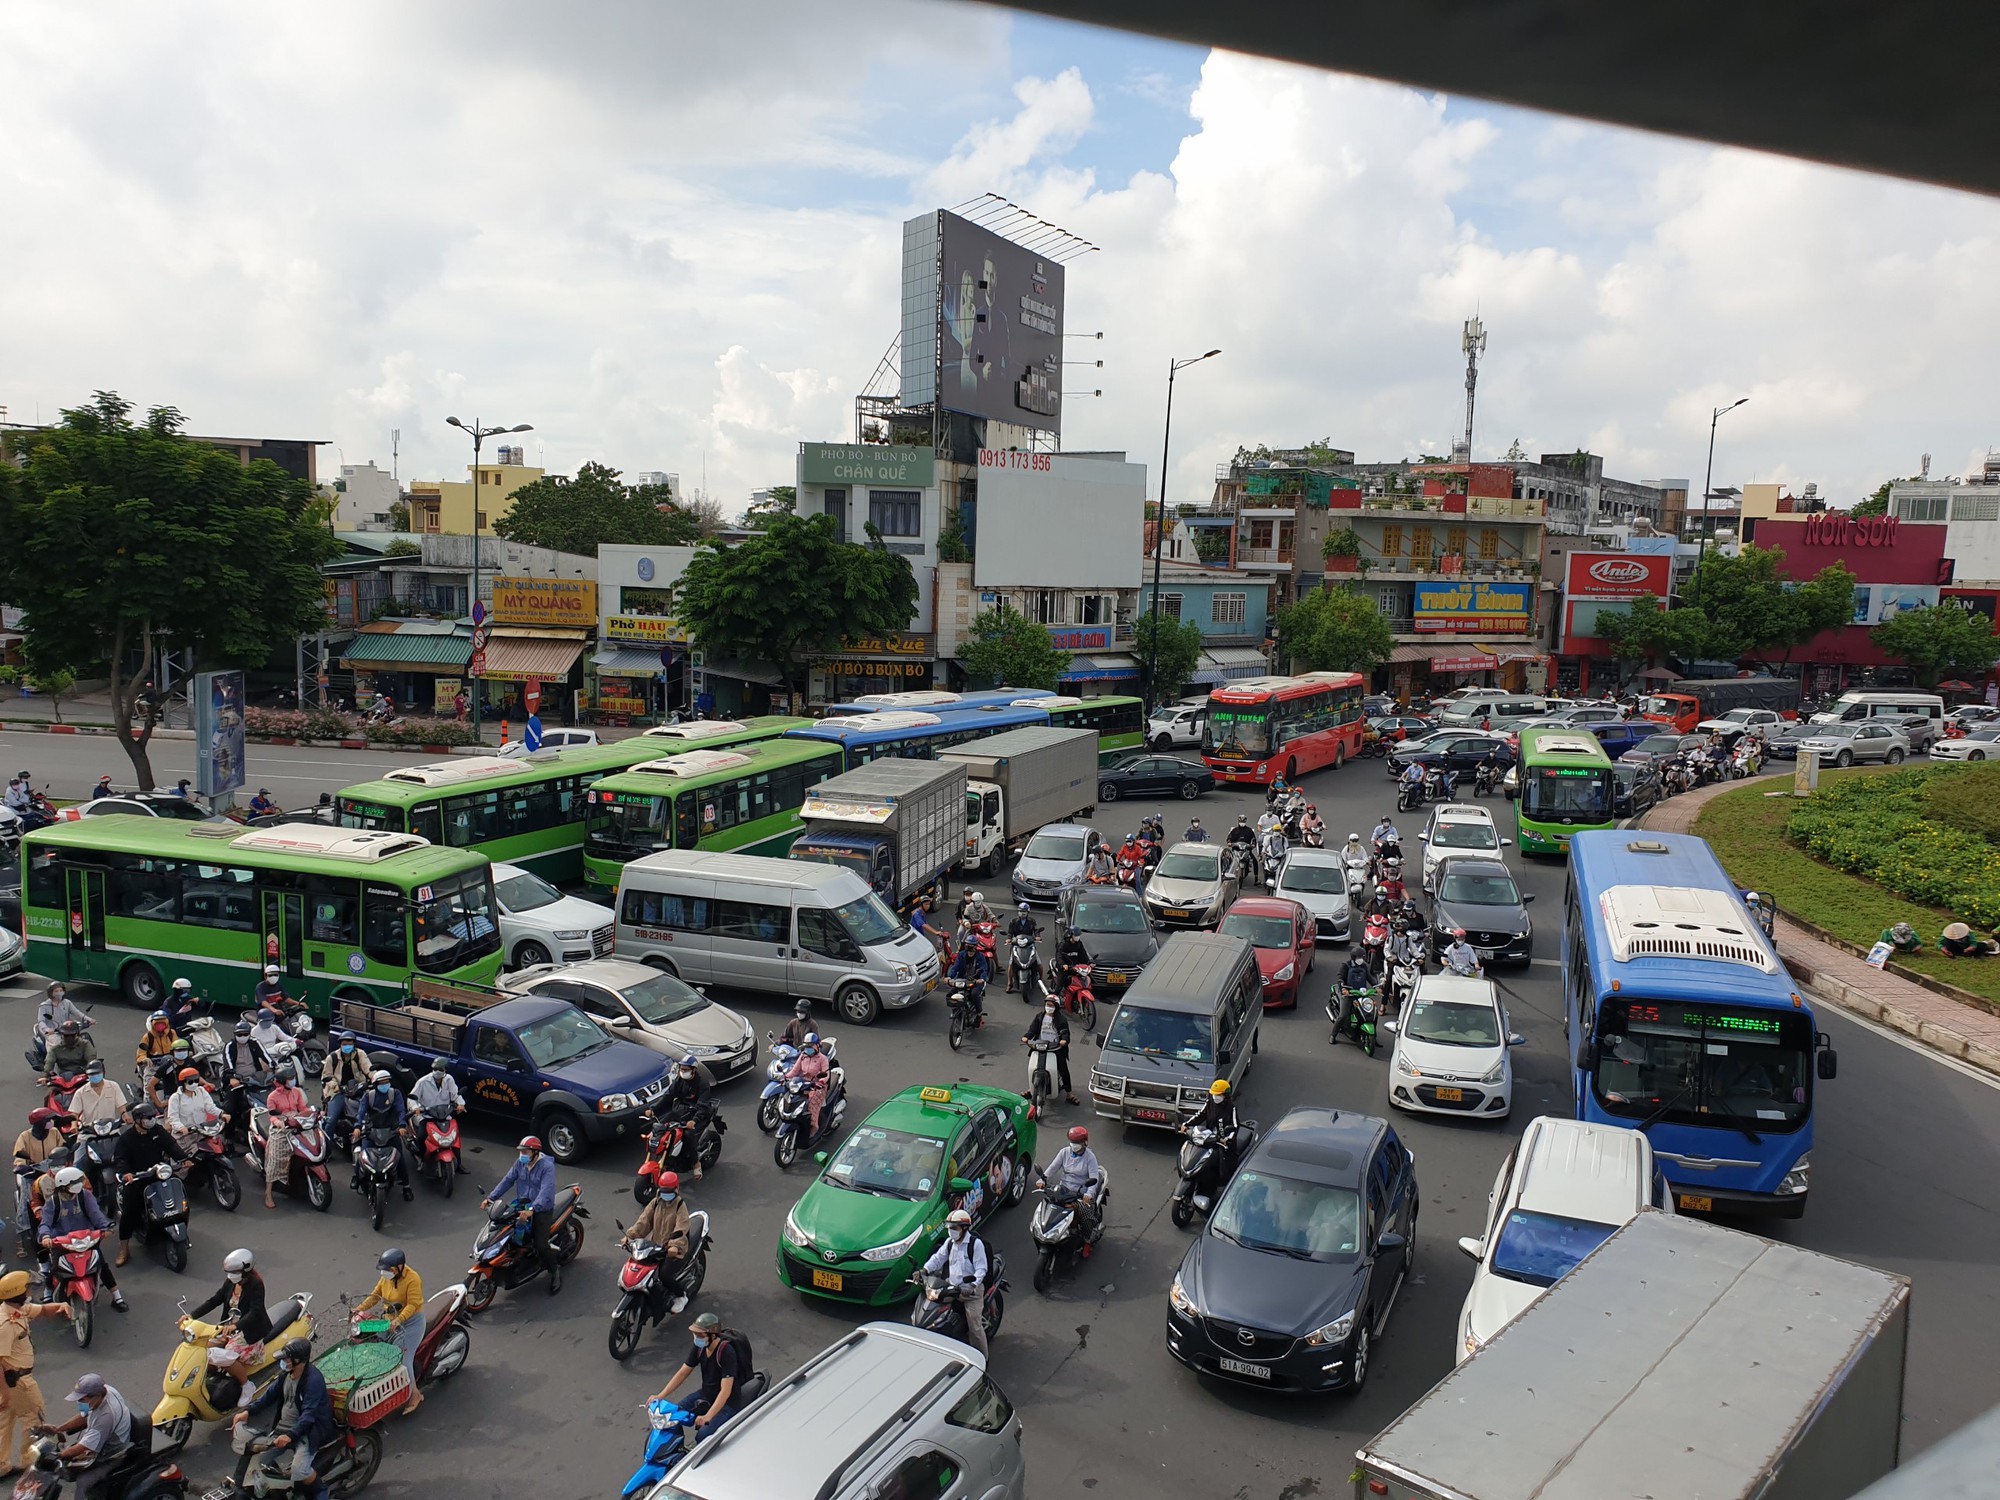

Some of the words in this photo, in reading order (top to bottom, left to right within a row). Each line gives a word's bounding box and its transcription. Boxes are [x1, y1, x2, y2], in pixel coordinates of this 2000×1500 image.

[821, 447, 845, 459] PHỞ
[848, 448, 864, 460] BÒ
[874, 449, 898, 462] BÚN
[901, 450, 917, 463] BÒ
[979, 450, 1006, 468] 0913
[1010, 452, 1029, 469] 173
[1032, 454, 1051, 472] 956
[834, 464, 873, 479] CHÂN
[879, 465, 907, 480] QUÊ
[1805, 506, 1851, 546] NÓN
[1854, 511, 1900, 547] SƠN
[1597, 562, 1644, 577] Andes
[503, 591, 525, 608] MỲ
[528, 592, 582, 611] QUẢNG
[1420, 588, 1473, 610] THỦY
[1475, 590, 1523, 611] BÌNH
[610, 619, 635, 629] Phở
[638, 621, 666, 631] HẬU
[876, 662, 902, 677] BÚN
[905, 662, 925, 677] BÒ
[421, 888, 431, 900] 91
[821, 1272, 835, 1281] 51G
